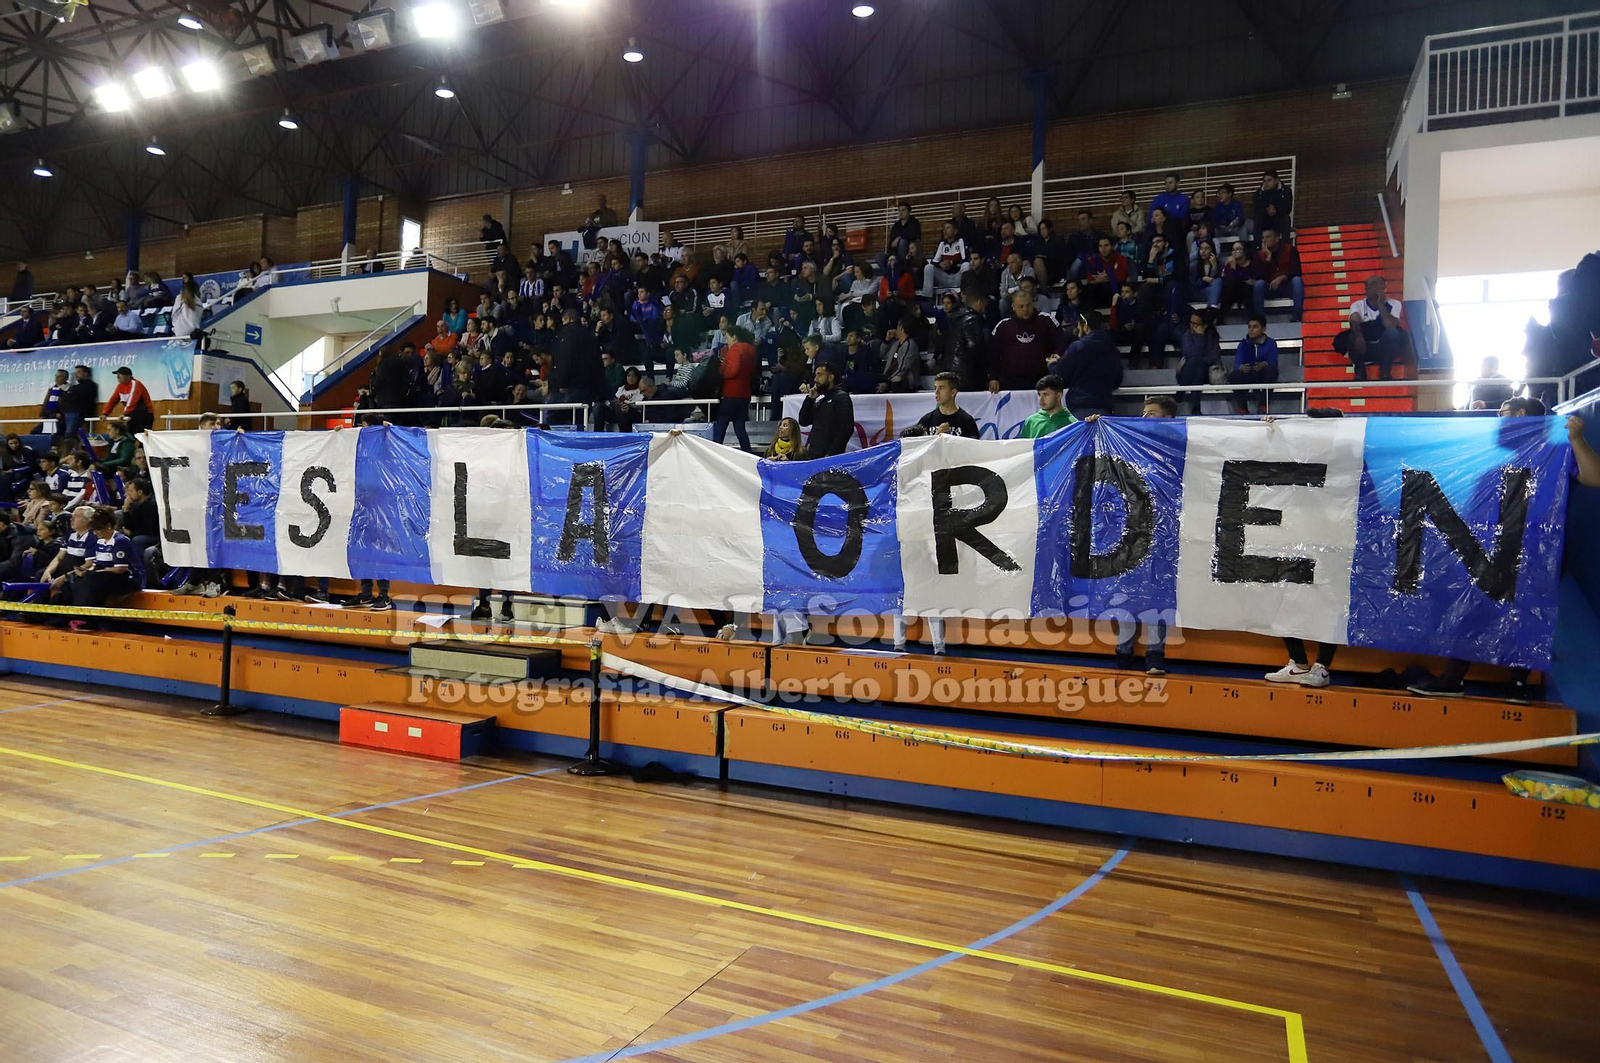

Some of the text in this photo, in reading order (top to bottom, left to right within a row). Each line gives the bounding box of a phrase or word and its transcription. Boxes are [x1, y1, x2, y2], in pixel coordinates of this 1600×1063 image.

[149, 455, 1532, 602] IES LA ORDEN
[815, 656, 829, 665] 64
[874, 661, 888, 670] 66
[937, 666, 952, 675] 68
[1223, 687, 1239, 699] 76
[1306, 694, 1323, 705] 78
[1392, 702, 1412, 713] 80
[1502, 710, 1523, 722] 82
[643, 708, 656, 717] 60
[772, 723, 786, 732] 64
[835, 730, 850, 740] 66
[1220, 771, 1239, 784] 76
[1315, 781, 1335, 793] 78
[1413, 792, 1435, 804] 80
[1541, 806, 1566, 820] 82
